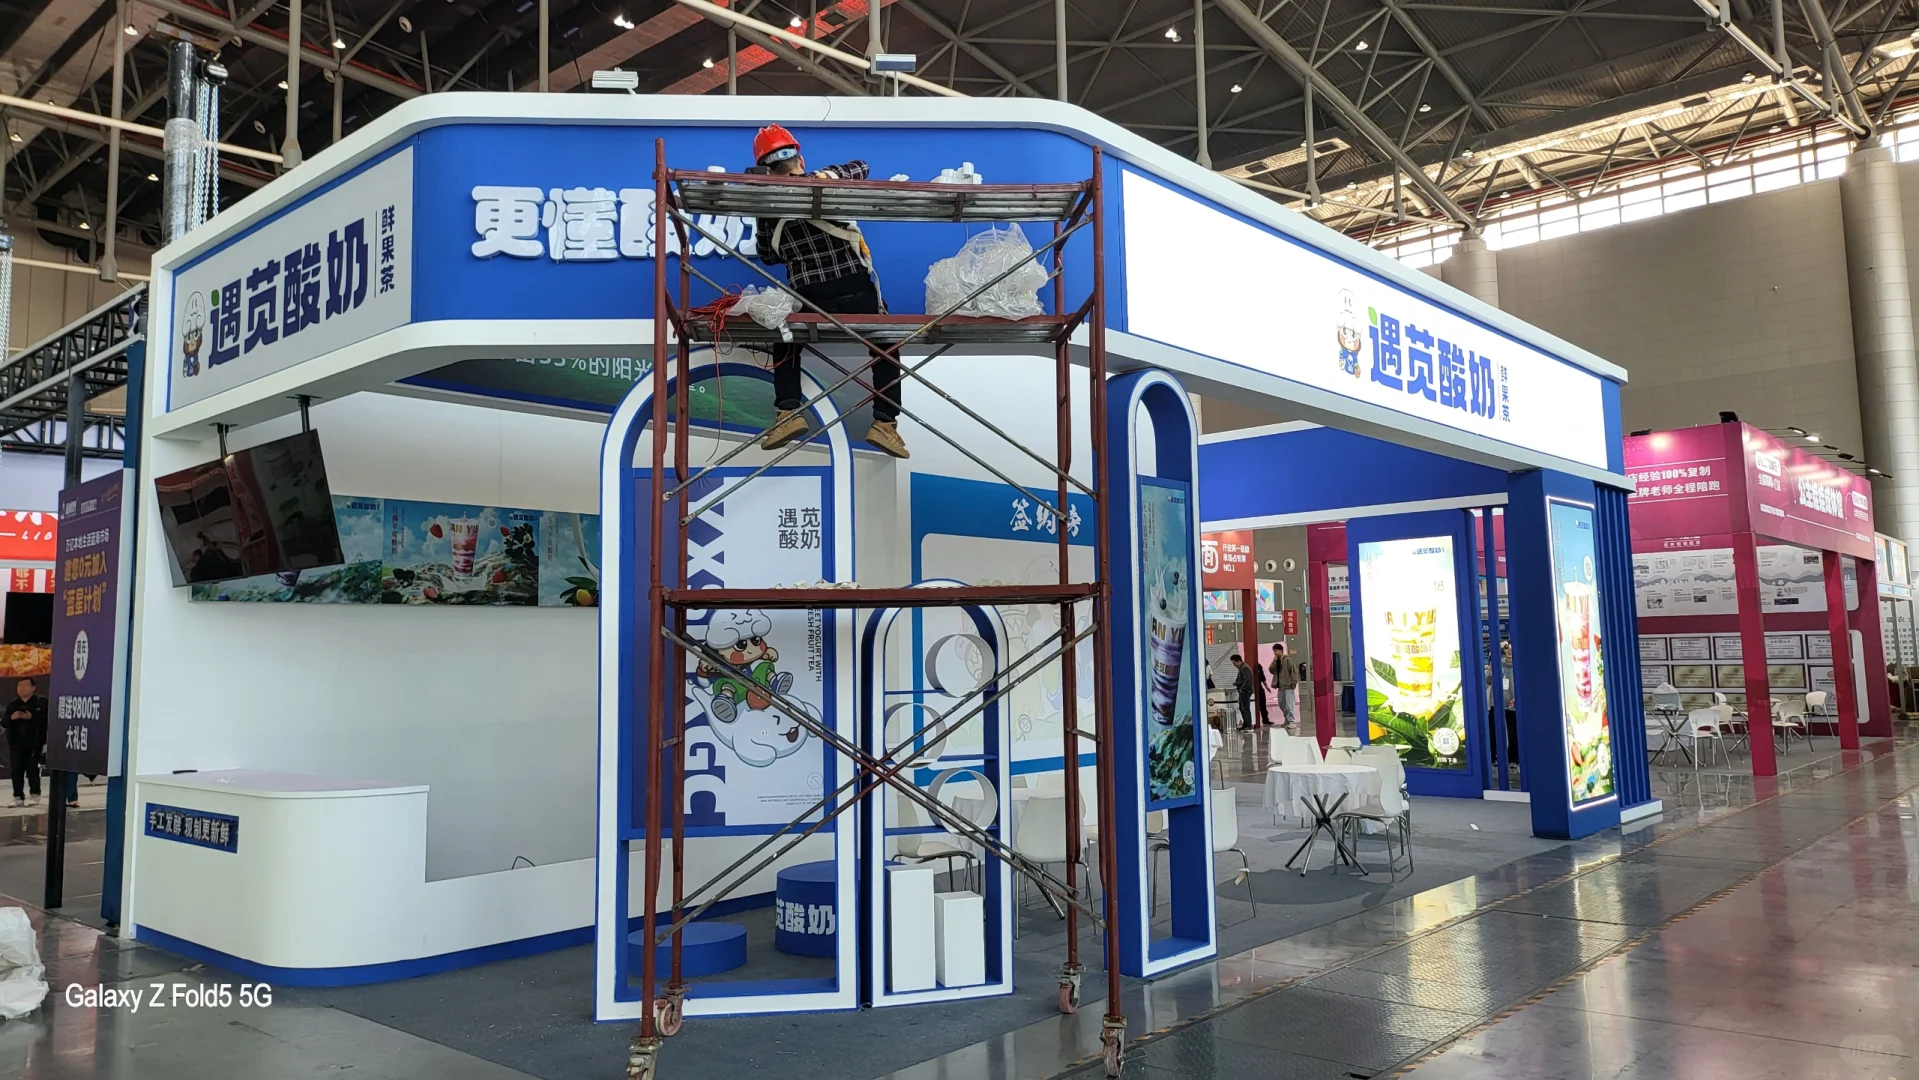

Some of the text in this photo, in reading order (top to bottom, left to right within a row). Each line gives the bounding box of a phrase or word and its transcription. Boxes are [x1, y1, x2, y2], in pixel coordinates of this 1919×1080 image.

[379, 204, 396, 295] 鲜果茶
[207, 217, 370, 370] 遇苋酸奶
[1367, 306, 1496, 420] 遇苋酸奶
[778, 528, 821, 550] 酸奶
[807, 629, 815, 653] FRUIT
[814, 625, 822, 658] YOGURT
[65, 724, 88, 751] 大礼包
[149, 811, 230, 847] 手工发酵 现制更新鲜
